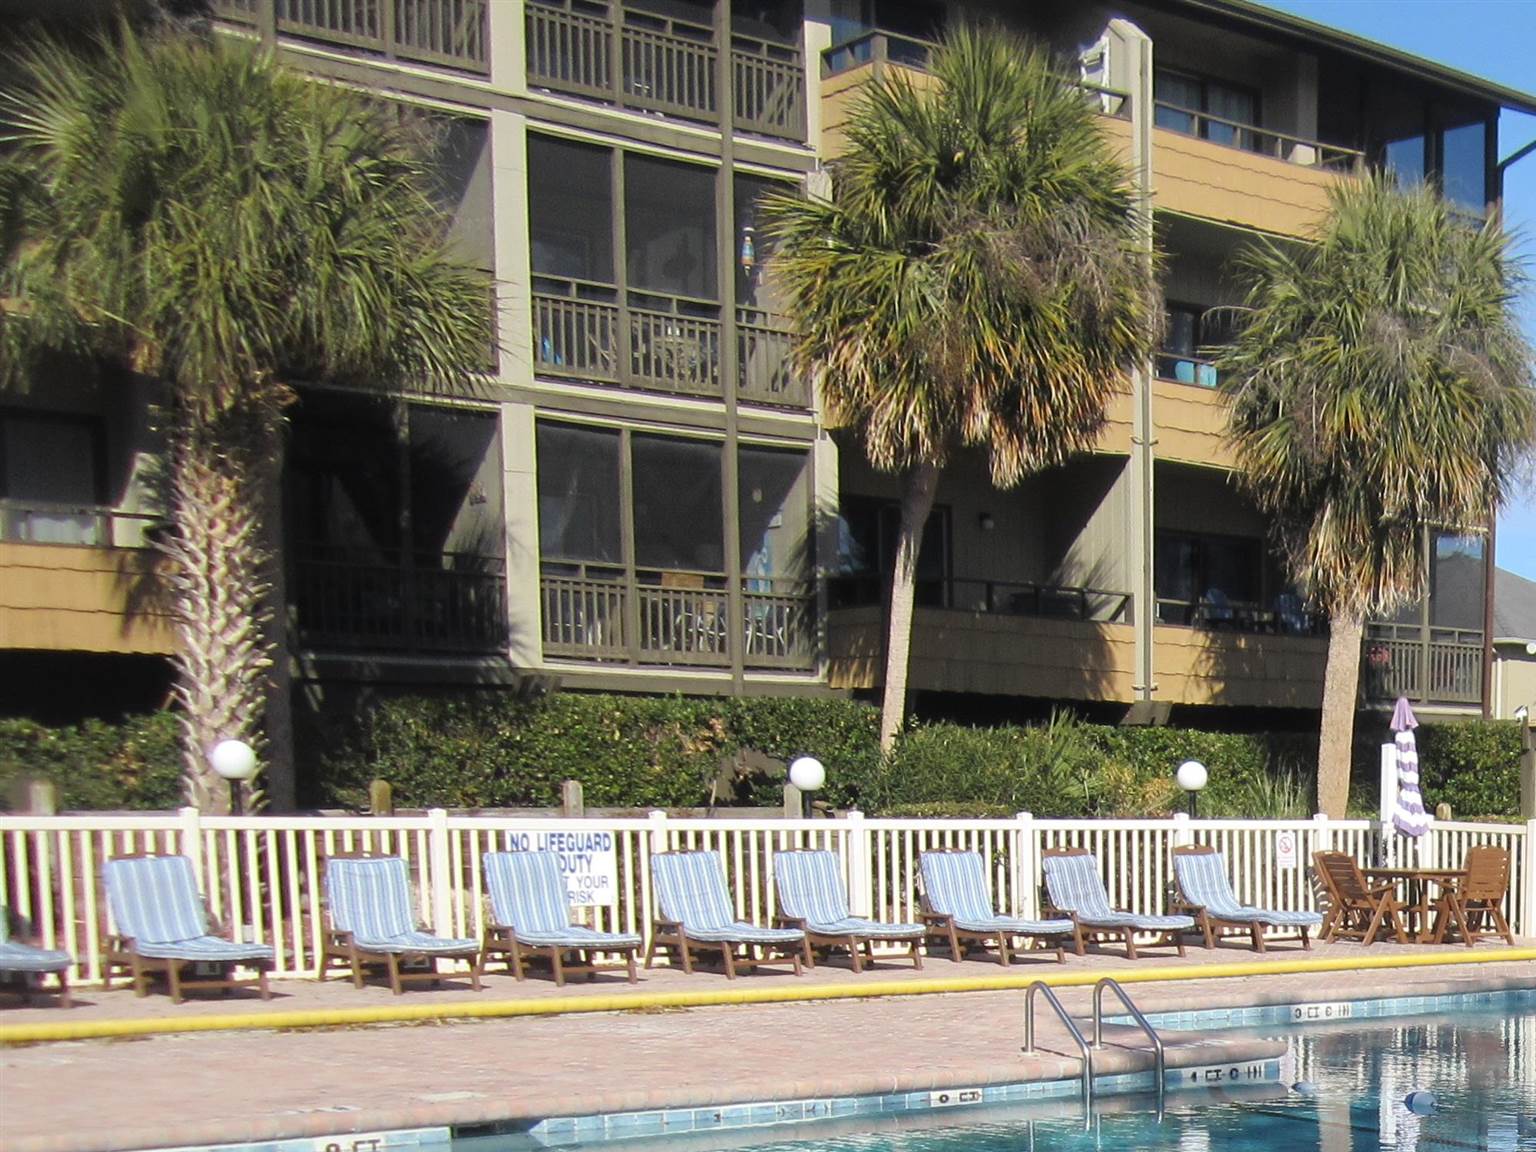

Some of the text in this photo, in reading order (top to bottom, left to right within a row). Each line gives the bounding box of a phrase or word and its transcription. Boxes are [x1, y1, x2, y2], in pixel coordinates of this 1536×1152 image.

[510, 832, 612, 851] NO LIFEGUARD
[576, 875, 610, 889] YOUR
